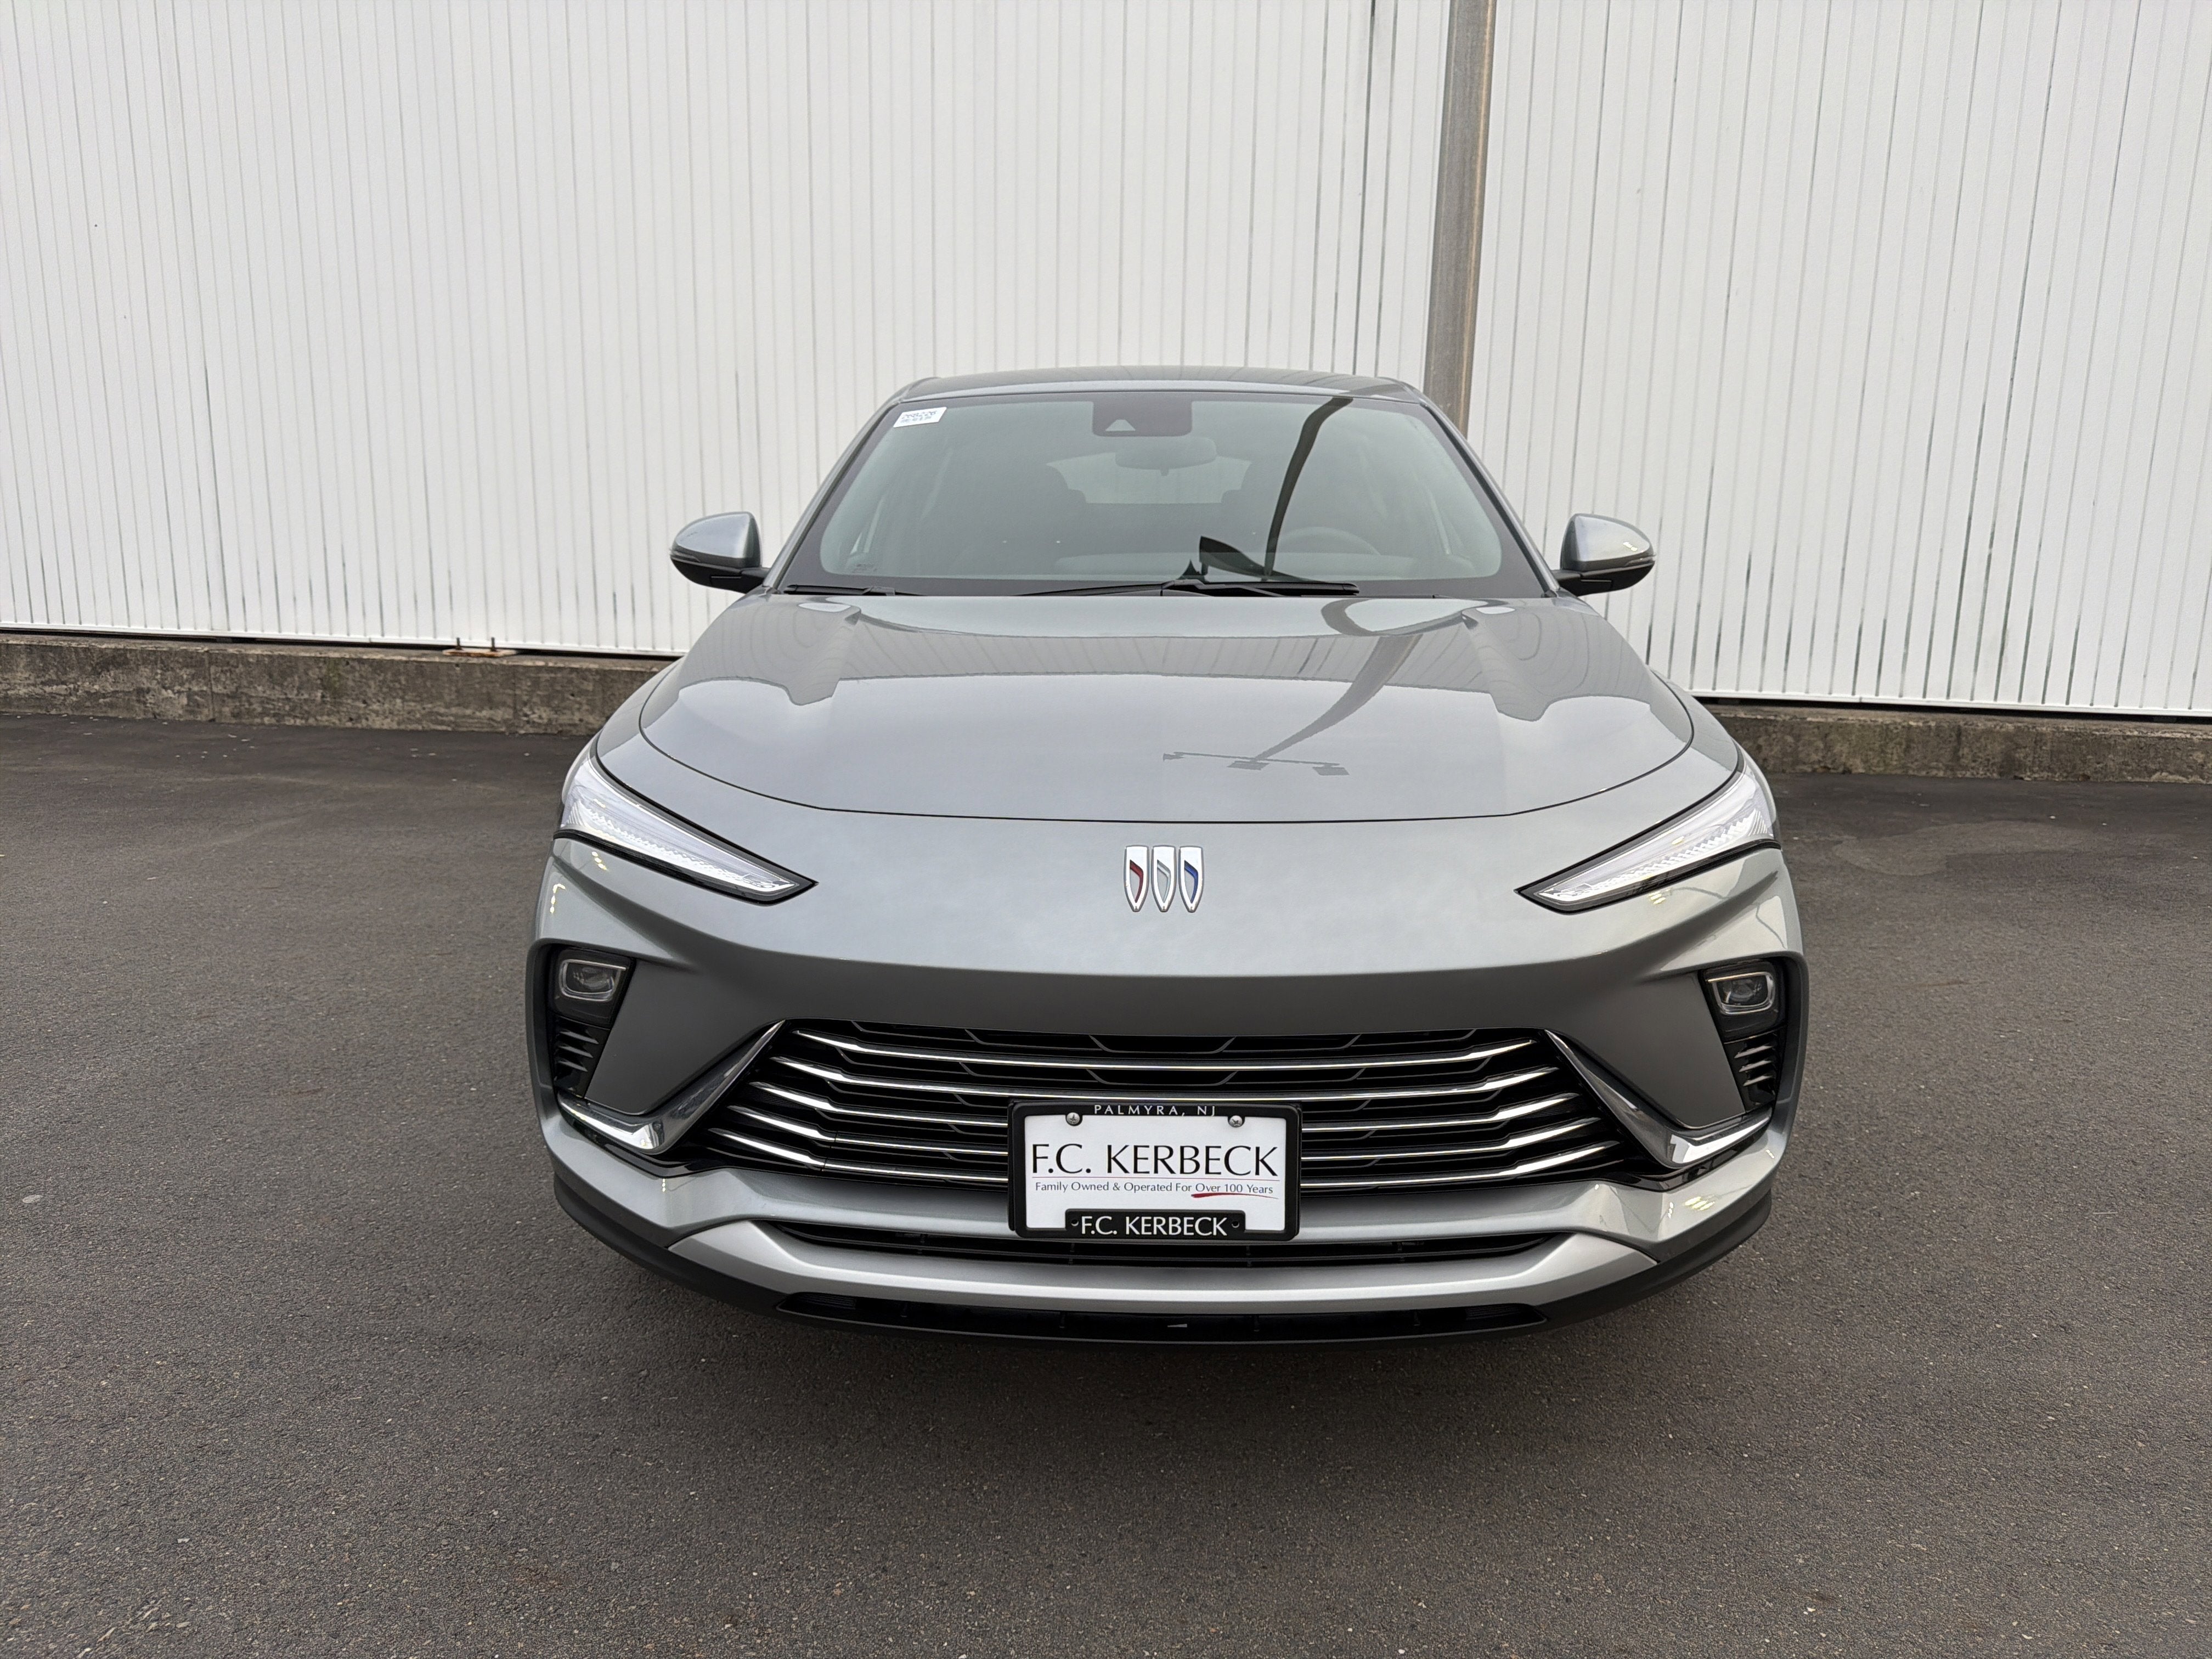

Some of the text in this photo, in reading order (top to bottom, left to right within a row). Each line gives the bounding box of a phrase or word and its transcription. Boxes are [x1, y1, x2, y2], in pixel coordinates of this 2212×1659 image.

[1094, 1104, 1215, 1116] PALMYRA, NJ
[1032, 1144, 1278, 1177] F.C. KERBECK
[1035, 1181, 1273, 1194] Family Owned & Operated For Over 100 Years
[1081, 1216, 1227, 1236] F.C. KERBECK
